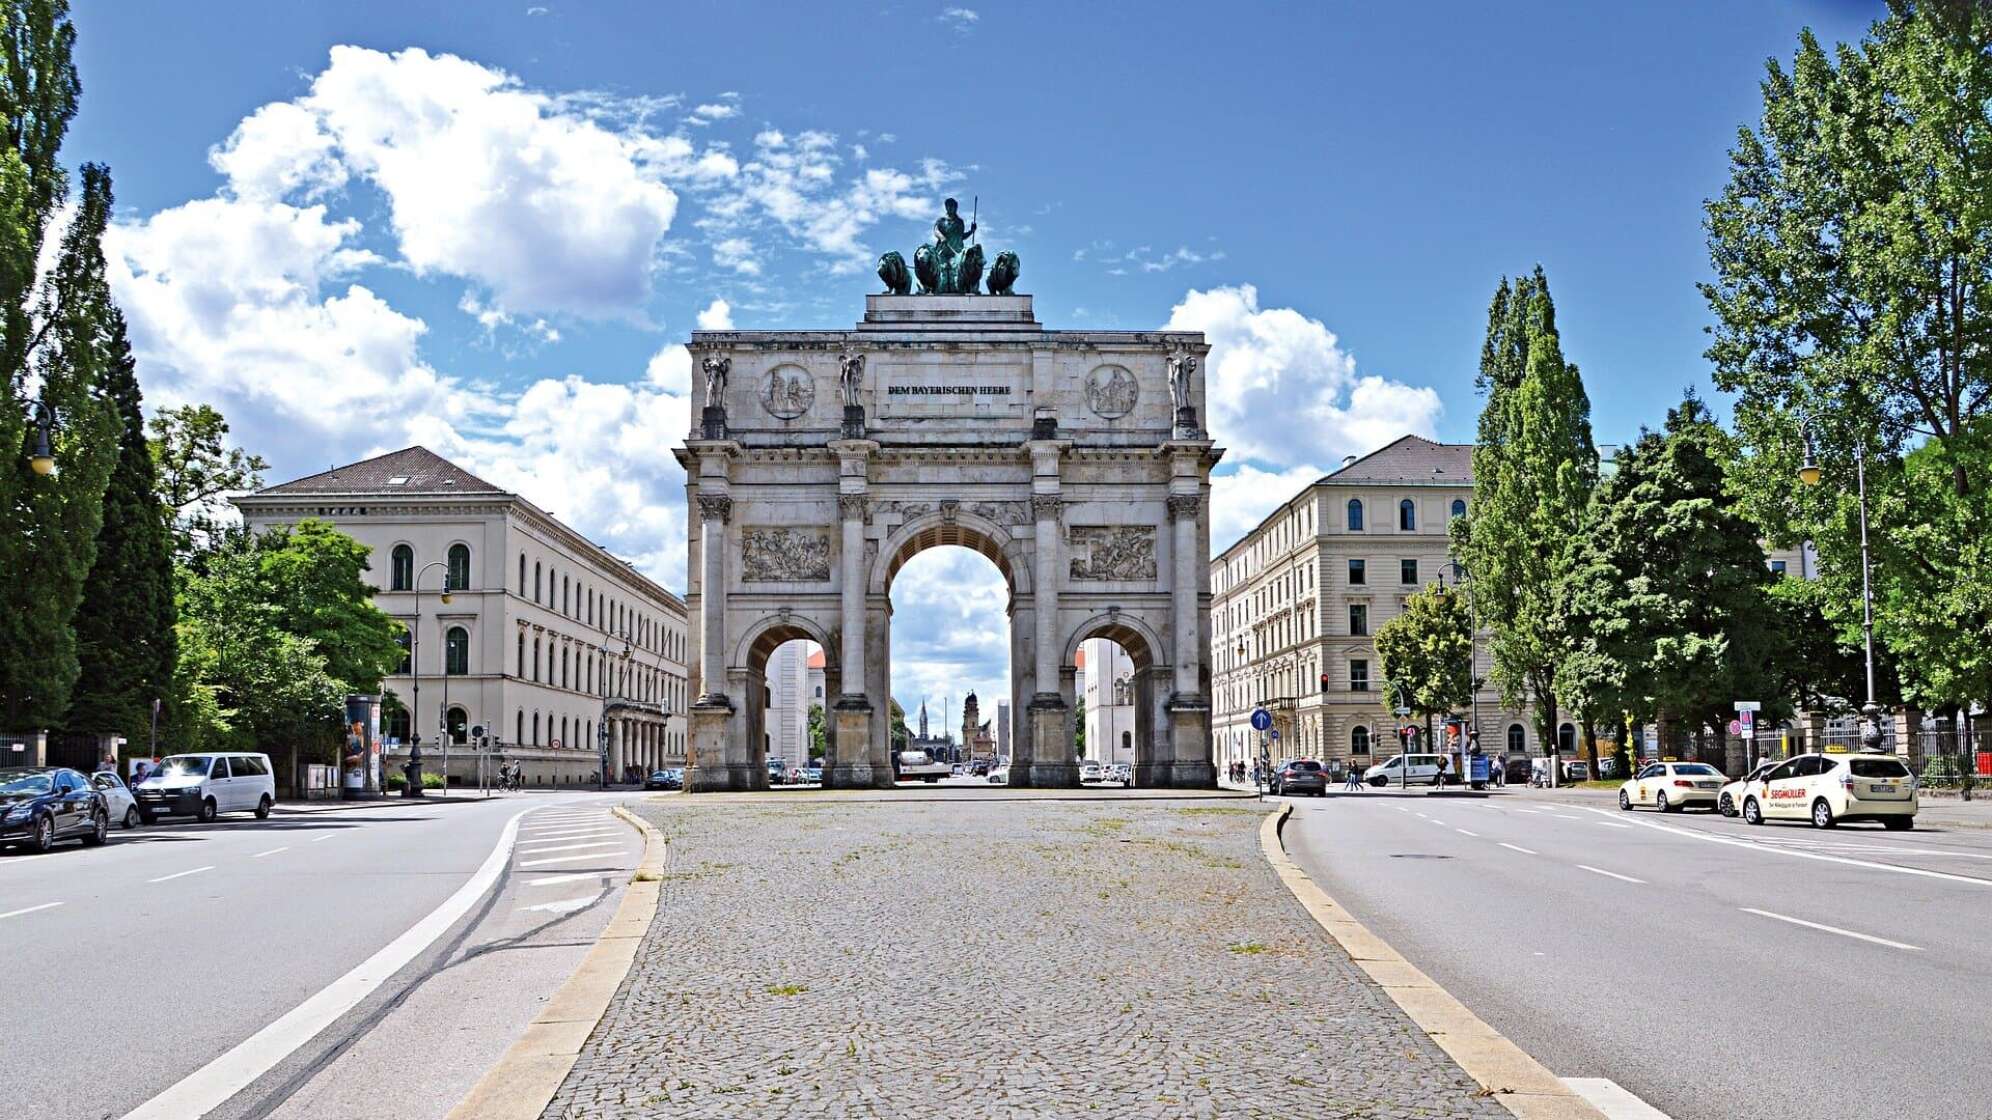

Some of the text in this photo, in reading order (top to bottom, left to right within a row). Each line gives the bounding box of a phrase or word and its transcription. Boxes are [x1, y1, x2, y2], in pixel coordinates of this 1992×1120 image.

[888, 386, 1011, 395] DEM BAYERISCHEN HEERE
